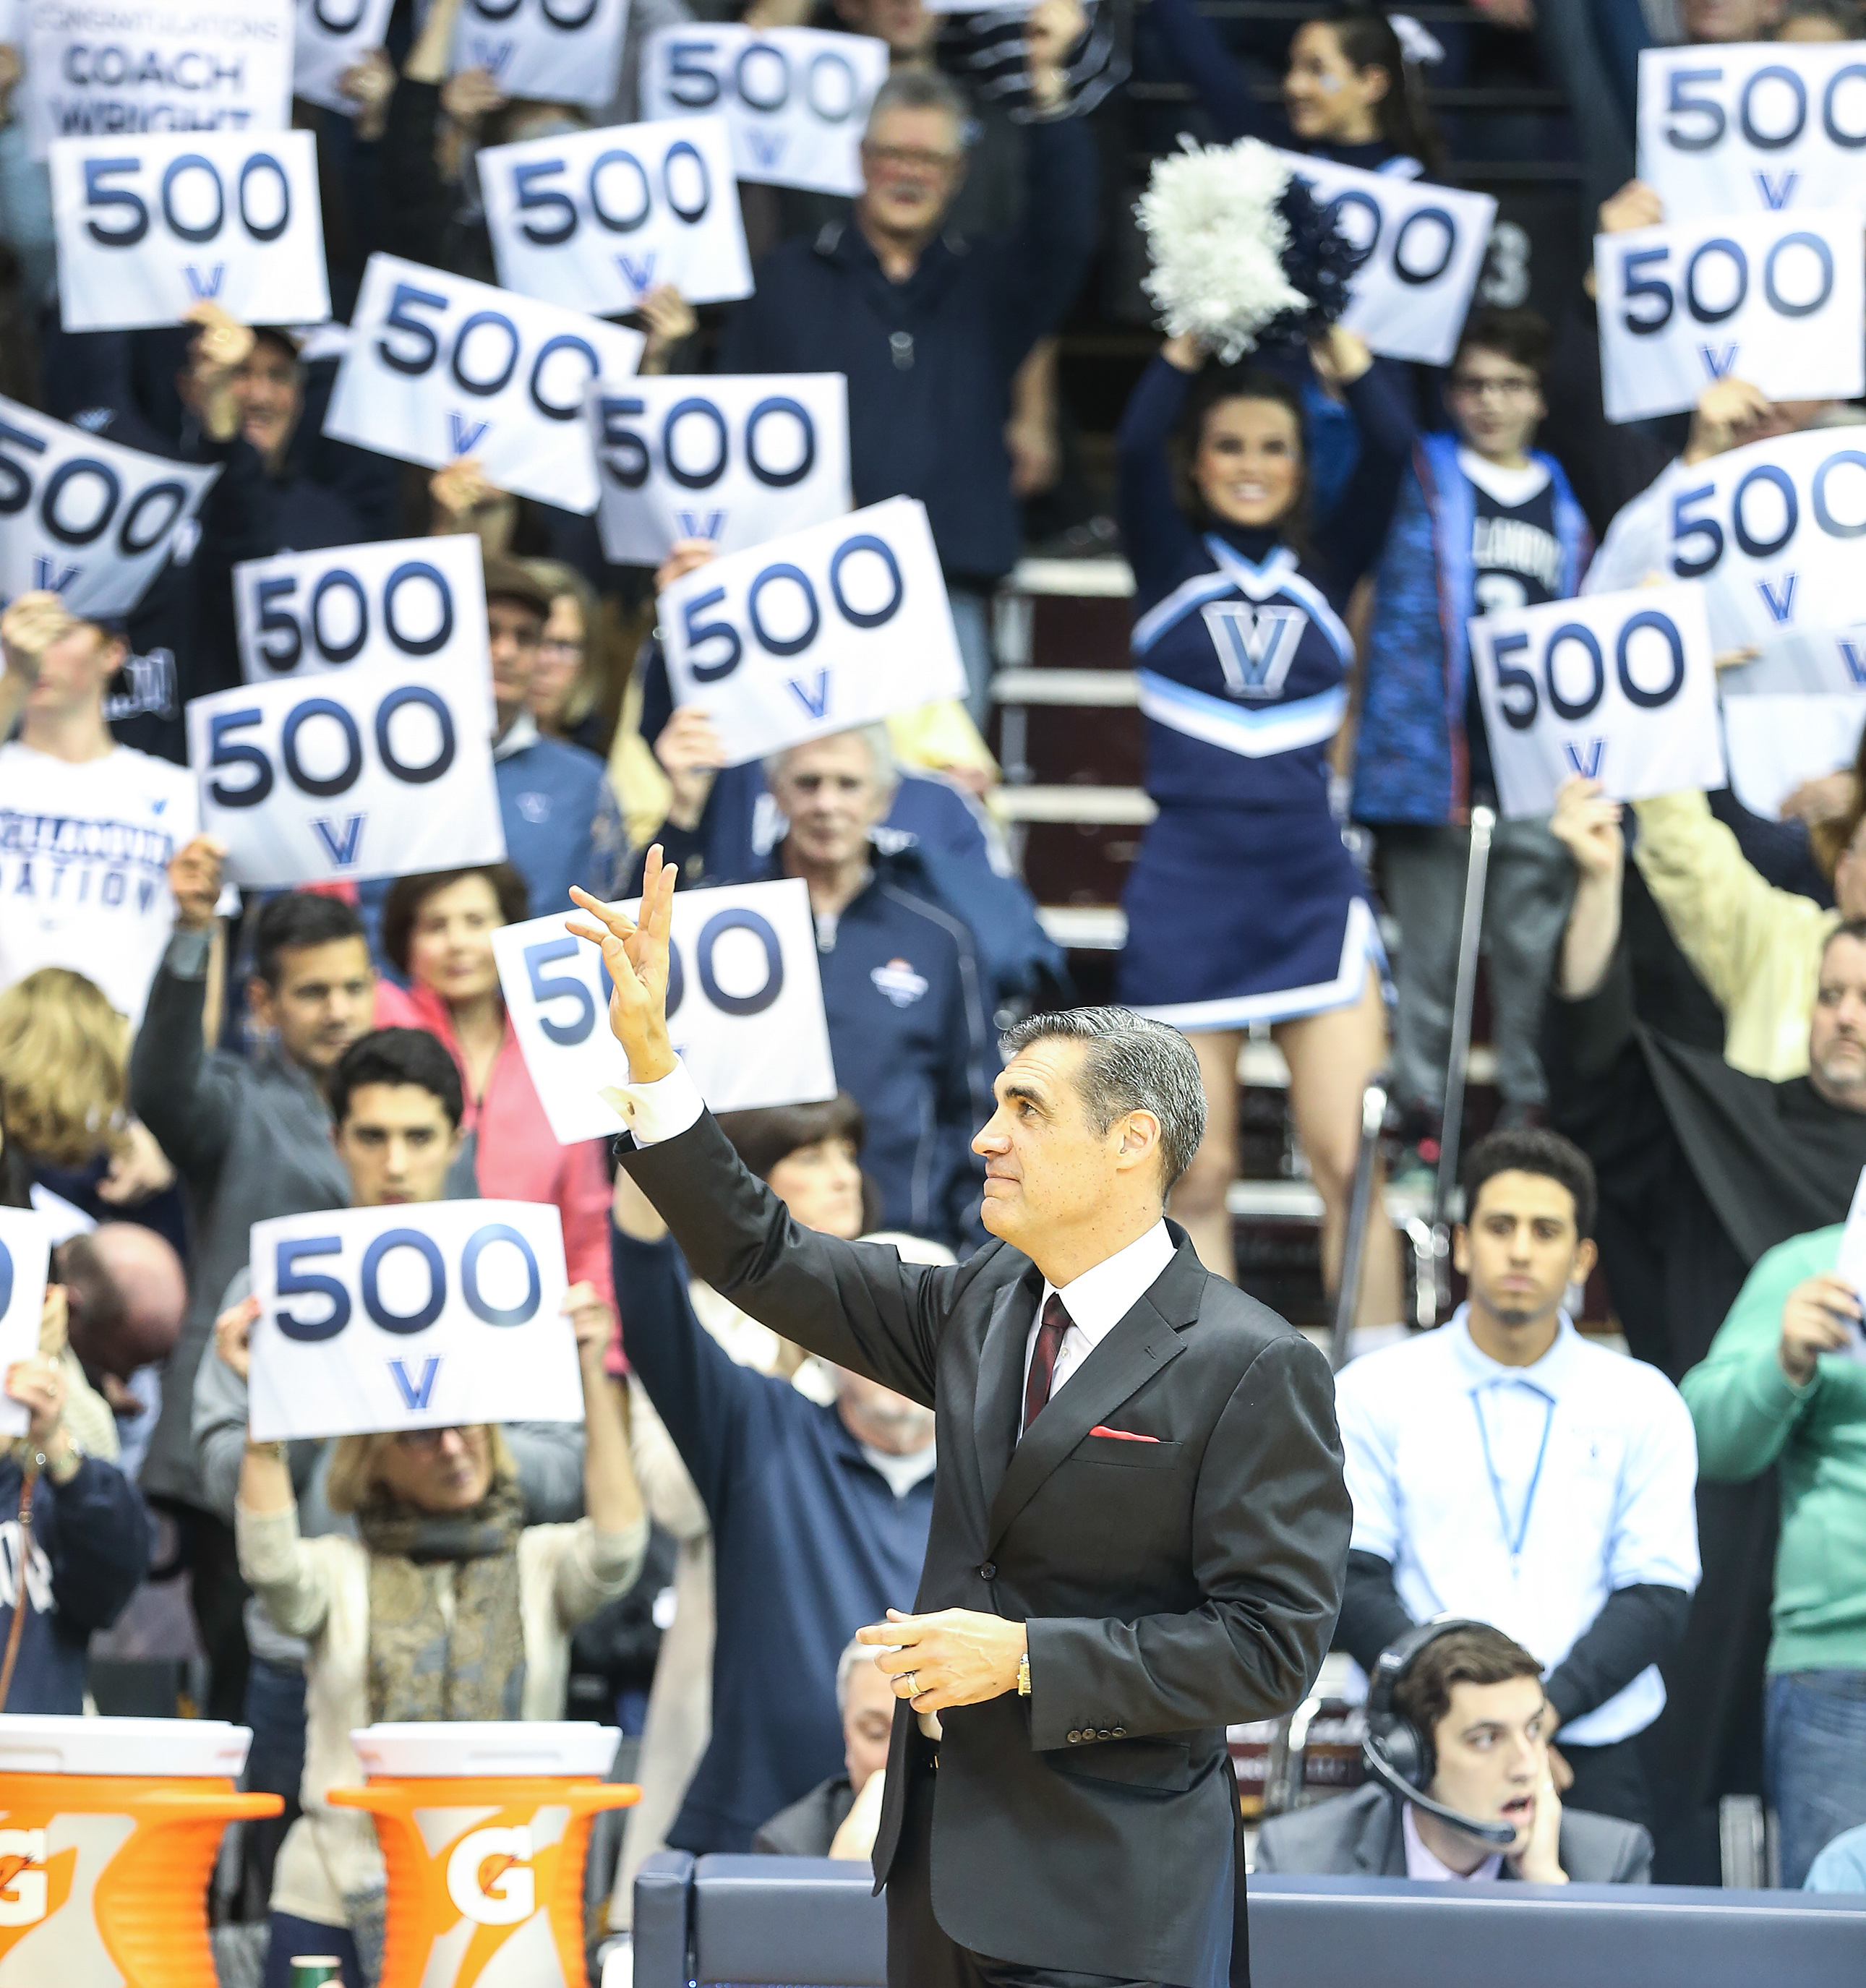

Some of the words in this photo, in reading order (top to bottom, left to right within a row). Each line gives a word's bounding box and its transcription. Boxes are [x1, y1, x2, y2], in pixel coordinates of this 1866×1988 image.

[62, 43, 247, 92] COACH
[667, 43, 860, 124] 500
[1666, 64, 1866, 152] 500
[84, 153, 291, 247] 500
[513, 140, 709, 245] 500
[1329, 191, 1457, 285] 00
[1622, 231, 1834, 334] 500
[375, 282, 600, 421] 500
[0, 425, 187, 557] 500
[597, 395, 816, 489] 500
[1672, 448, 1866, 578] 500
[253, 562, 453, 674] 500
[682, 534, 904, 684] 500
[1491, 610, 1685, 730] 500
[208, 685, 455, 808] 500
[0, 859, 158, 915] ATION
[274, 1223, 542, 1342] 500
[447, 1825, 536, 1926] G
